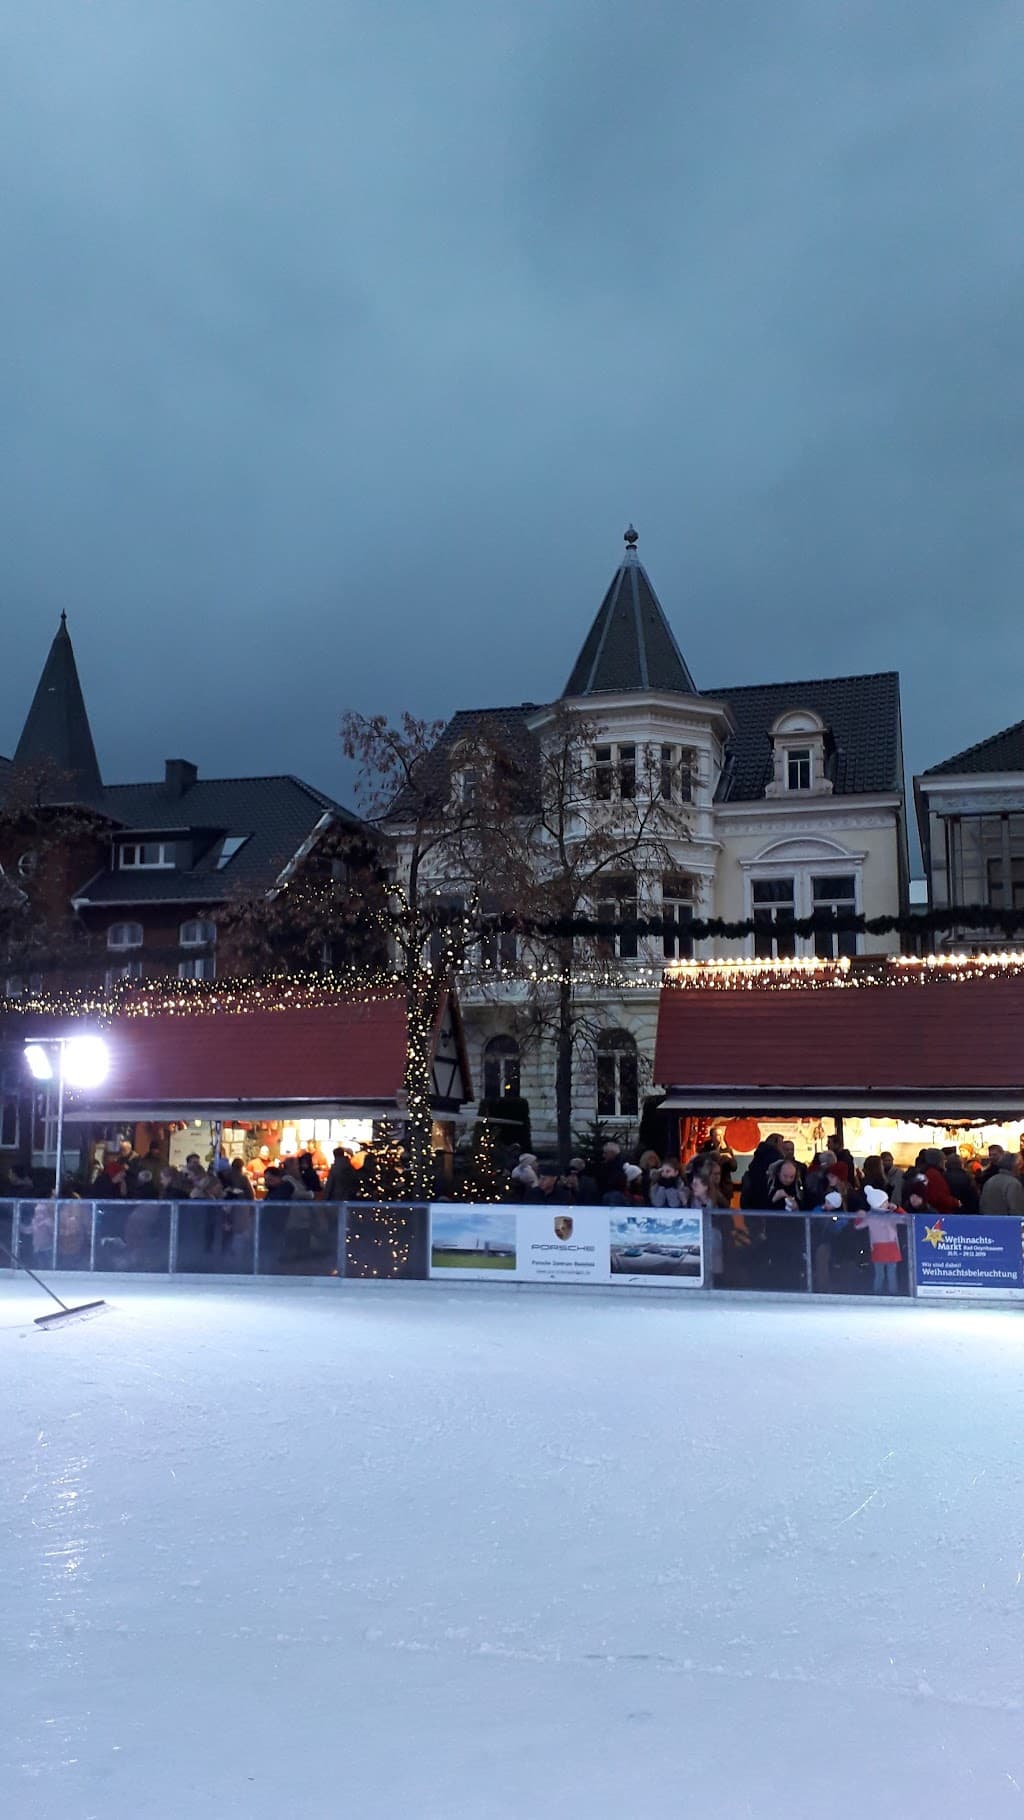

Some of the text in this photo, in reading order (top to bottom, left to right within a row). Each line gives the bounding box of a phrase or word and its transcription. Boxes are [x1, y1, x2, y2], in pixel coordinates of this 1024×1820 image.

[944, 1236, 995, 1244] Weihnachts-
[938, 1243, 962, 1251] Markt
[922, 1268, 1018, 1279] Weihnachtsbeleuchtung
